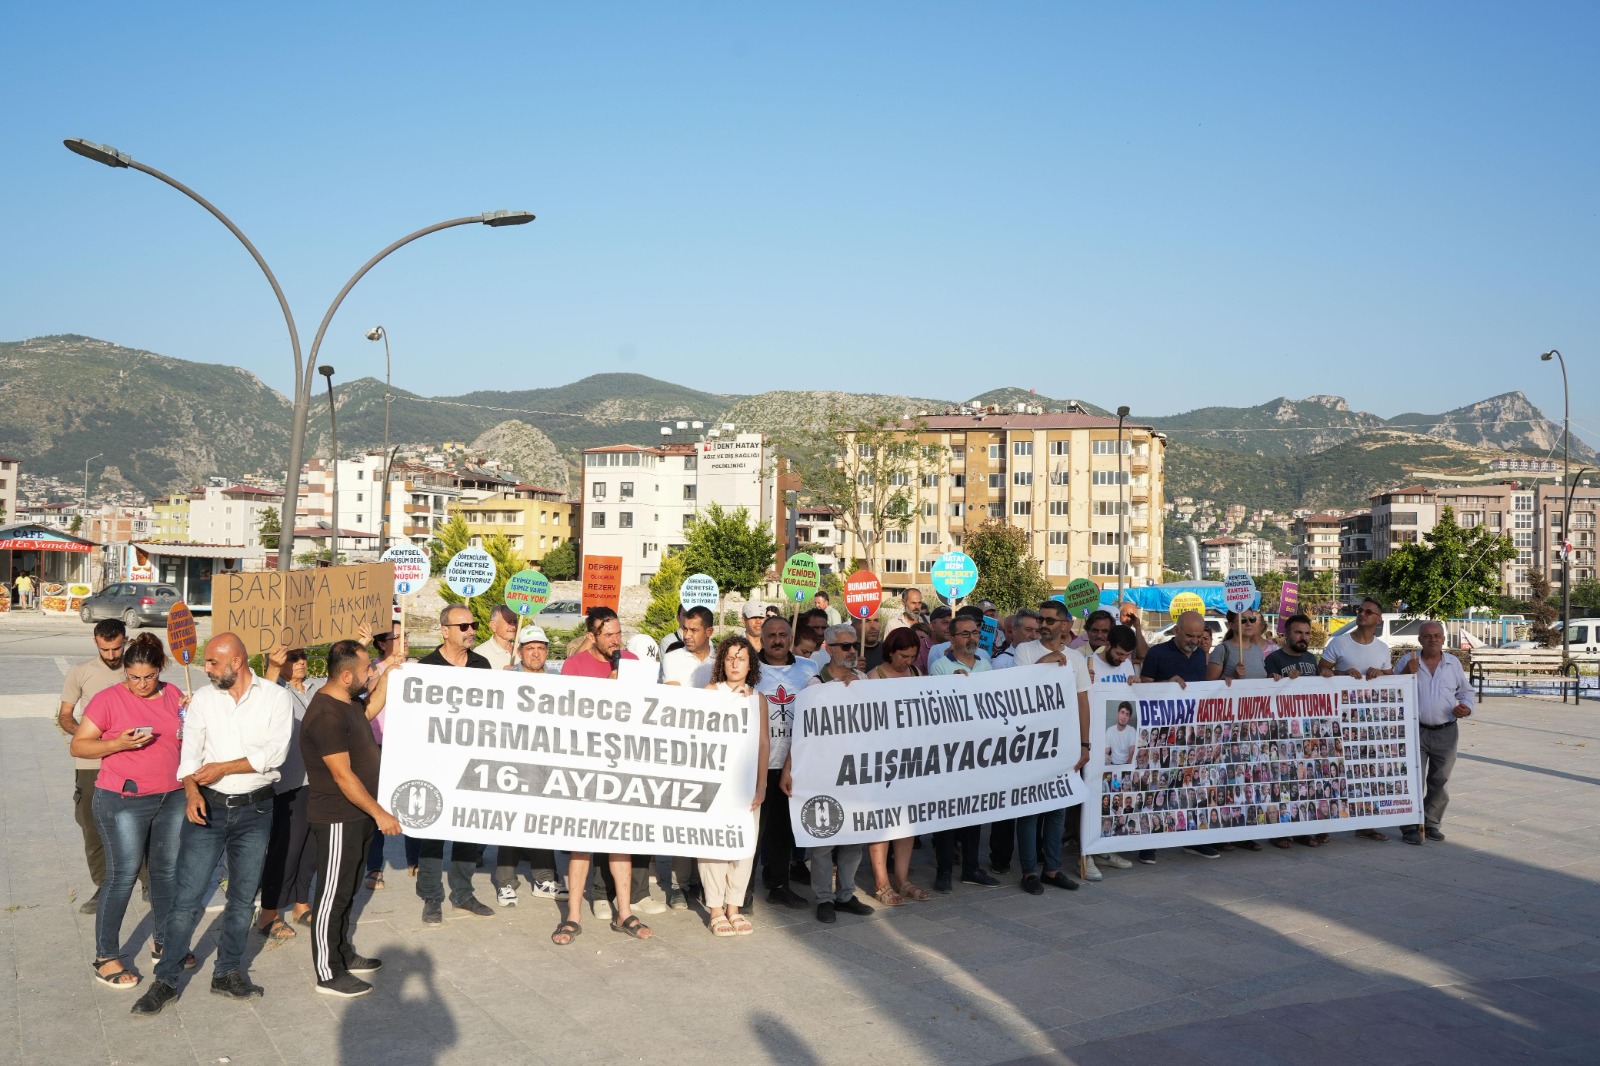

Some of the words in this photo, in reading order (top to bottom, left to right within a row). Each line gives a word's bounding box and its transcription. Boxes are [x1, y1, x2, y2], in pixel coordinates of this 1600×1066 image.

[31, 540, 89, 550] Yemekleri
[229, 574, 331, 603] BARINMA
[347, 570, 367, 590] VE
[784, 578, 817, 587] KURACAĞIZ
[787, 568, 816, 578] YENİDEN
[848, 581, 878, 591] BURADAYIZ
[507, 592, 528, 601] ARTIK
[531, 595, 547, 603] YOK!
[847, 592, 880, 603] GİTMİYORUZ
[1068, 588, 1095, 601] YENİDEN
[1068, 595, 1098, 609] KURACAĞIZ
[228, 602, 315, 630] MÜLKİYET
[330, 592, 382, 615] HAKKIMA
[260, 608, 385, 652] DOKUNMA!
[402, 677, 505, 713] Geçen
[518, 685, 631, 722] Sadece
[642, 697, 748, 734] Zaman!
[804, 701, 889, 738] MAHKUM
[895, 689, 973, 728] ETTİĞİNİZ
[973, 682, 1065, 725] KOŞULLARA
[1197, 698, 1234, 723] HATIRLA,
[1238, 696, 1275, 720] UNUTMA,
[427, 716, 727, 771] NORMALLEŞMEDİK!
[771, 727, 792, 737] İ.H.
[836, 725, 1059, 788] ALIŞMAYACAĞIZ!
[473, 763, 530, 792] 16.
[542, 768, 703, 809] AYDAYIZ
[853, 806, 902, 831] HATAY
[908, 790, 1006, 824] DEPREMZEDE
[1011, 774, 1074, 806] DERNEĞİ
[452, 806, 517, 832] HATAY
[524, 813, 655, 842] DEPREMZEDE
[663, 823, 744, 849] DERNEĞİ
